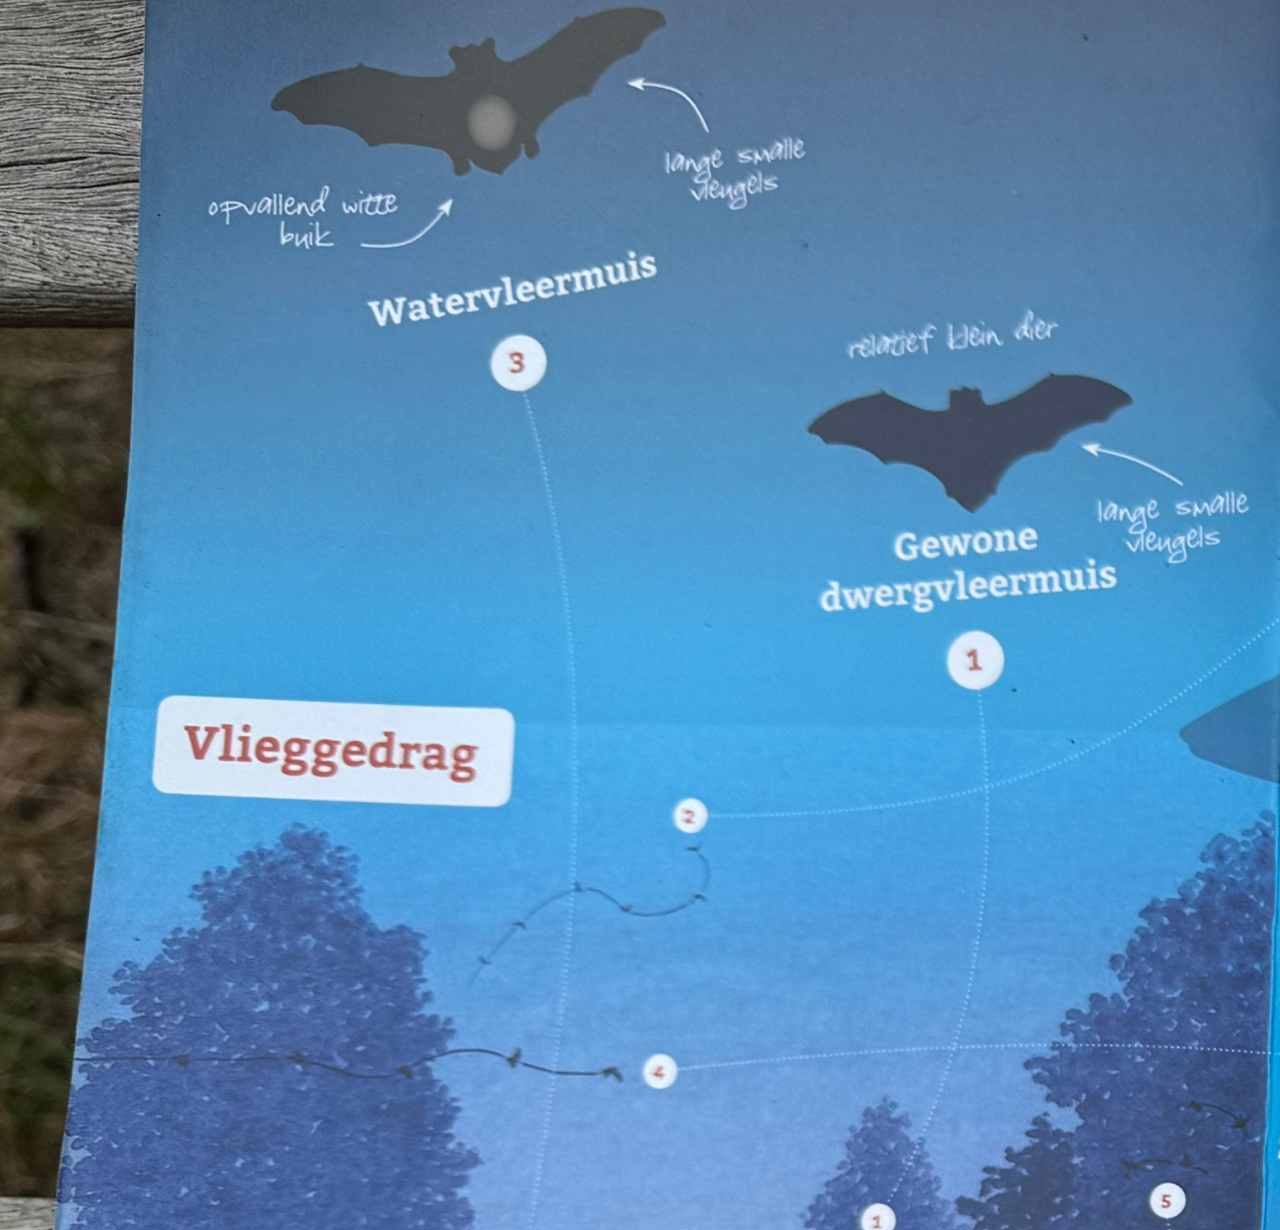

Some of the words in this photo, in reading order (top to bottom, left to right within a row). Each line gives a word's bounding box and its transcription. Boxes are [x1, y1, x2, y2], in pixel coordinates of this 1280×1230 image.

[666, 149, 723, 178] lange
[738, 138, 805, 164] smalle
[209, 186, 329, 224] opvallend
[342, 191, 398, 215] witte
[690, 173, 778, 210] vleugels
[280, 221, 334, 249] buik
[368, 251, 657, 326] Watervleermuis
[848, 324, 937, 358] relatief
[1014, 310, 1058, 340] dier
[509, 352, 525, 373] 3
[1098, 499, 1159, 536] lange
[1176, 491, 1249, 517] smalle
[894, 528, 1037, 561] Gewone
[1126, 526, 1220, 564] vleugels
[820, 554, 1117, 613] dwergvleermuis
[966, 649, 983, 671] 1
[184, 724, 478, 783] Vlieggedrag
[683, 809, 695, 824] 2
[654, 1065, 665, 1080] 4
[1161, 1194, 1172, 1208] 5
[872, 1214, 881, 1229] 1
